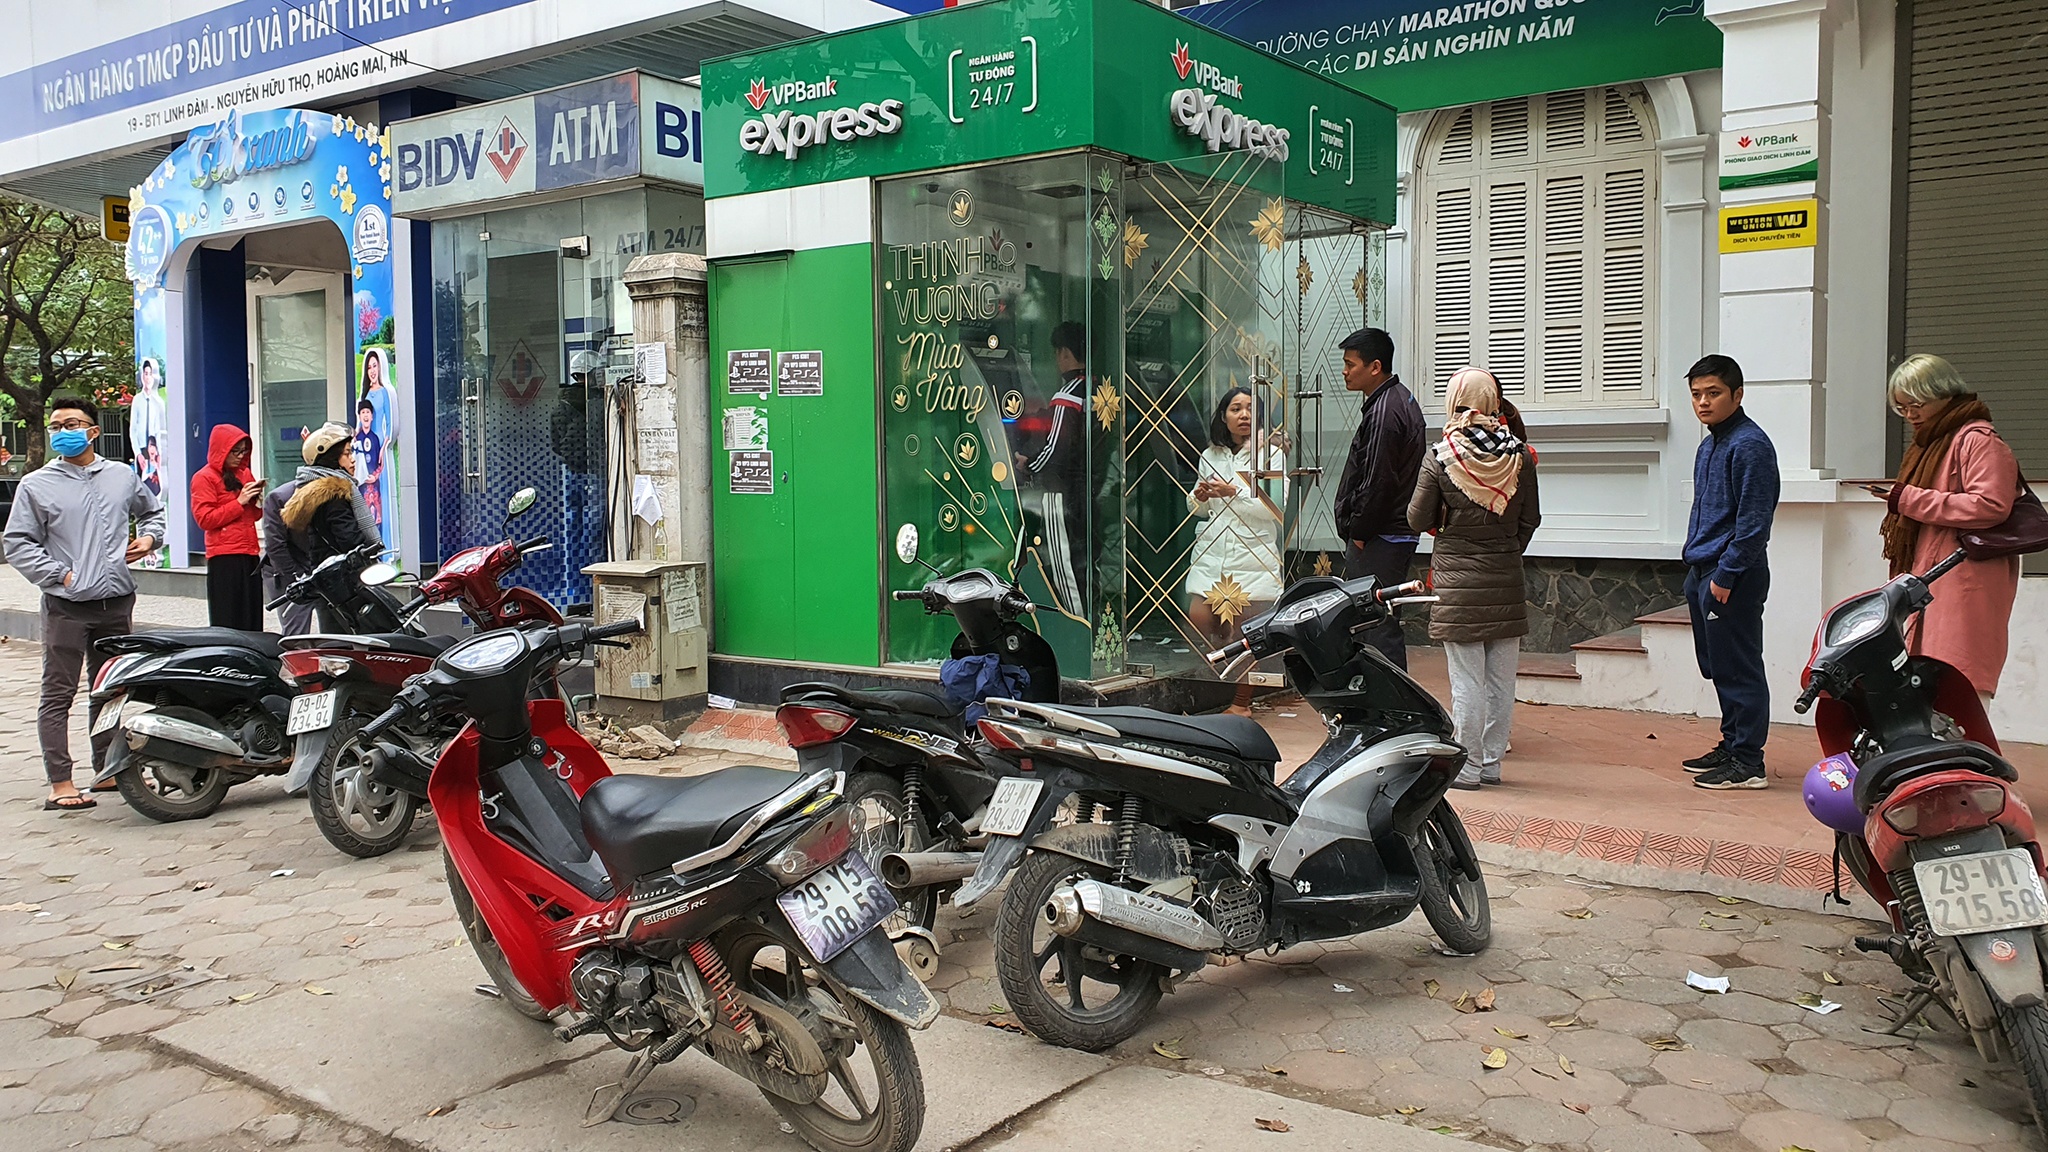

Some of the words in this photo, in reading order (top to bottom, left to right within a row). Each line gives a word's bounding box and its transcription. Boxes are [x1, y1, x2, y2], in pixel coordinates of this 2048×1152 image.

[1335, 17, 1395, 44] CHẠY
[1398, 0, 1527, 35] MARATHON
[992, 50, 1015, 63] HÀNG
[1355, 50, 1377, 71] DI
[1382, 37, 1428, 66] SẢN
[1434, 24, 1511, 58] NGHÌN
[1516, 15, 1576, 44] NĂM
[42, 69, 85, 114] NGÂN
[89, 59, 134, 102] HÀNG
[137, 43, 183, 87] TMCP
[187, 23, 224, 74] ĐẦU
[228, 16, 255, 62] TƯ
[257, 6, 283, 54] VÀ
[985, 65, 1015, 81] ĐỘNG
[127, 118, 137, 133] 19
[145, 112, 161, 129] BT1
[163, 106, 185, 124] LINH
[187, 97, 209, 118] ĐÀM
[217, 82, 259, 110] NGUYỄN
[262, 76, 285, 98] HỮU
[317, 57, 359, 86] HOÀNG
[390, 49, 408, 69] HN
[771, 75, 838, 106] VPBank
[1193, 59, 1244, 100] VPBank
[969, 82, 1014, 109] 24/7
[549, 101, 619, 167] ATM
[1754, 133, 1799, 147] VPBank
[397, 128, 484, 193] BIDV
[1320, 148, 1344, 170] 24/7
[1779, 150, 1795, 158] LINH
[364, 219, 376, 231] 1st
[1729, 215, 1773, 226] WESTERN
[1777, 213, 1803, 228] WU
[1742, 222, 1773, 231] UNION
[615, 230, 657, 255] ATM
[664, 225, 705, 250] 24/7
[889, 236, 985, 283] THỊNH
[893, 281, 1001, 328] VƯỢNG
[743, 367, 769, 377] PS4
[792, 369, 819, 379] PS4
[916, 371, 989, 424] Vàng
[744, 468, 770, 477] PS4
[365, 653, 411, 664] VISION
[290, 710, 329, 733] 234.94
[984, 806, 1027, 831] 294.90
[793, 859, 863, 921] 29-Y5
[1933, 855, 2018, 895] 29-M1
[641, 901, 691, 927] SIRIUS
[690, 897, 708, 911] RC
[821, 884, 891, 946] 08.58
[1935, 888, 2041, 928] 215.58
